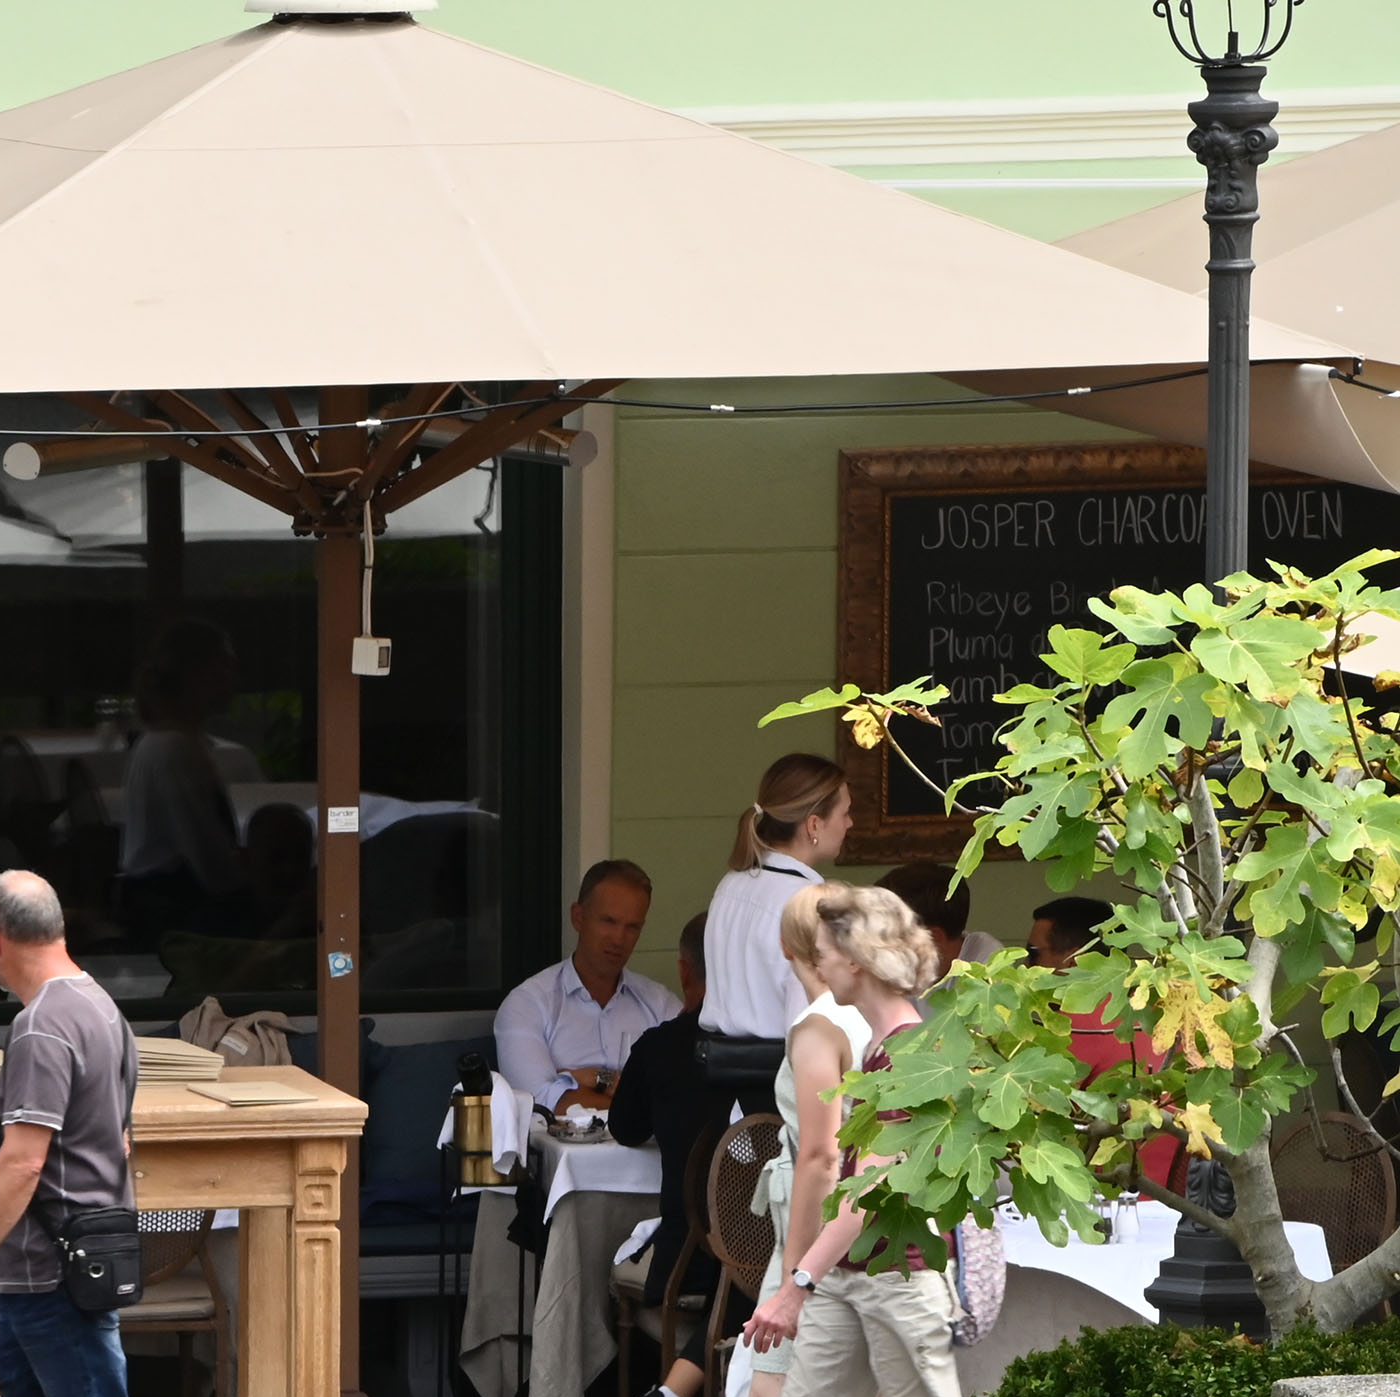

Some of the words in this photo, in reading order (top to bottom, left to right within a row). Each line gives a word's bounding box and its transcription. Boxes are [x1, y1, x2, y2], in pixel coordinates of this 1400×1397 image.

[921, 500, 1057, 551] JOSPER
[1079, 493, 1206, 546] CHARCOA
[1262, 490, 1344, 541] OVEN
[927, 580, 1032, 636] Ribeye
[929, 626, 1015, 667] Pluma
